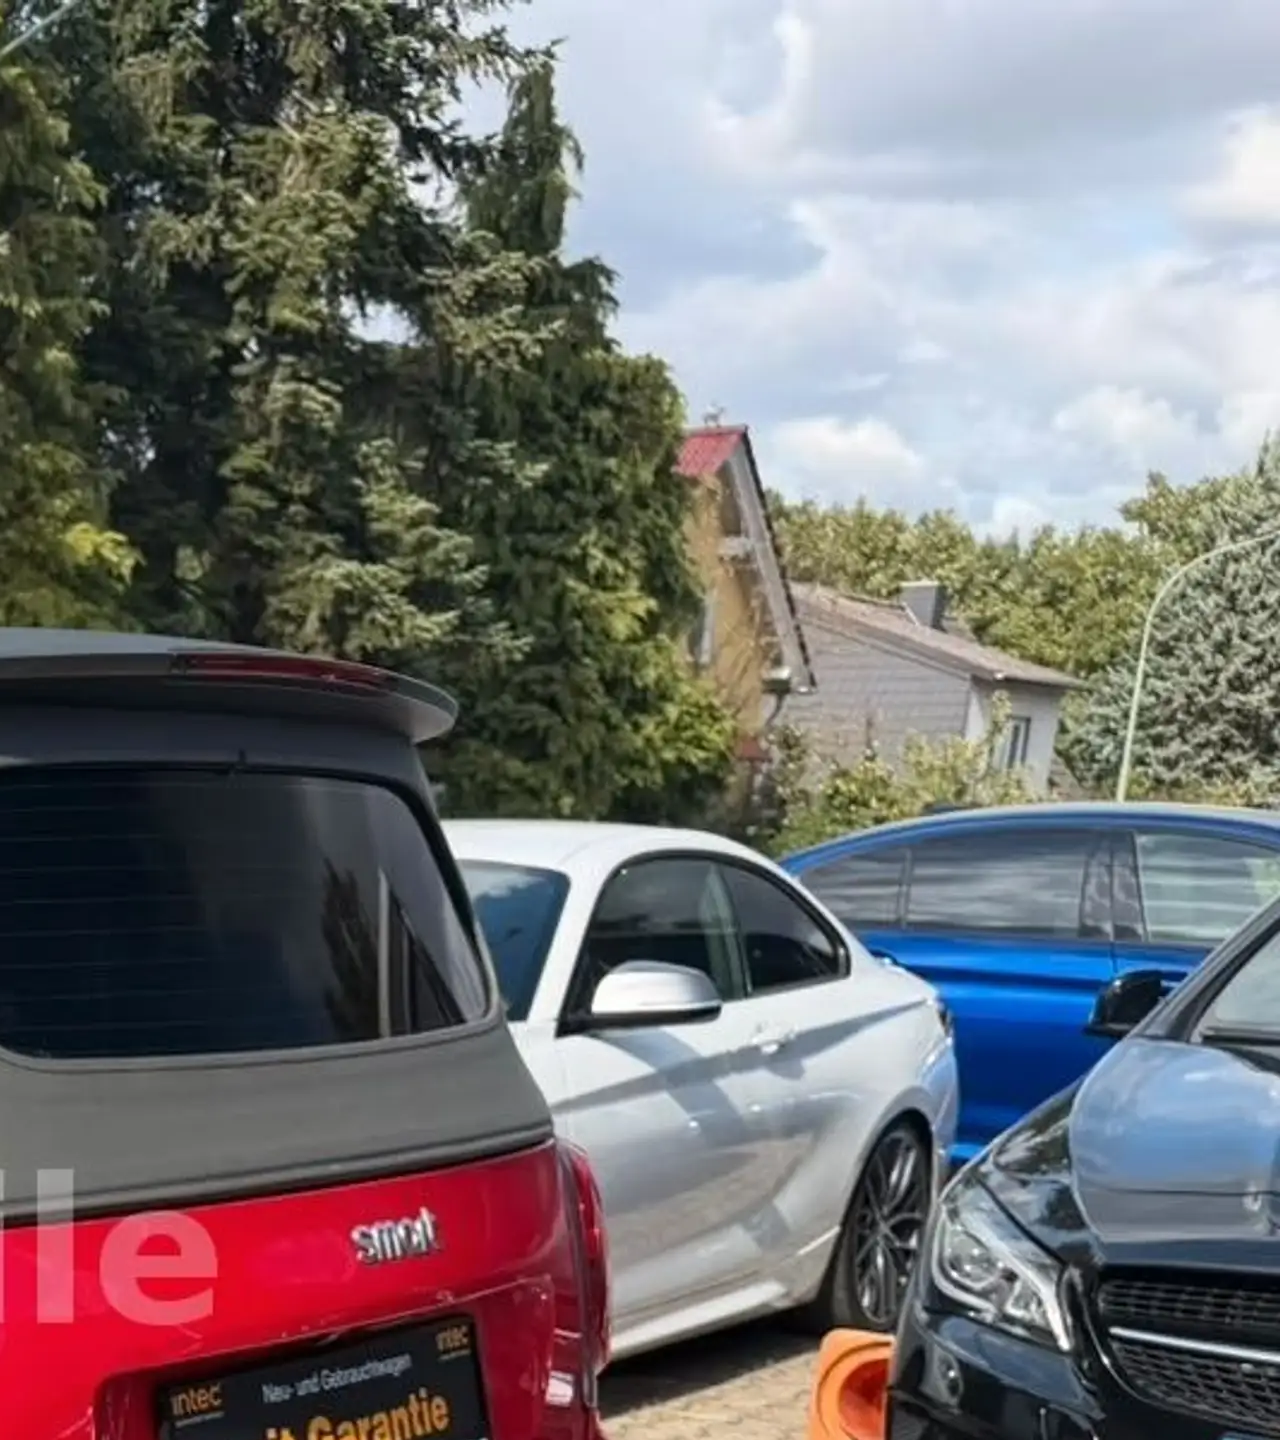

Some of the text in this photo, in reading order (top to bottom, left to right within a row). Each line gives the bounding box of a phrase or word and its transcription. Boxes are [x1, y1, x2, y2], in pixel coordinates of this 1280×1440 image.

[350, 1206, 438, 1263] smart
[170, 1382, 223, 1416] intec
[295, 1371, 320, 1396] und
